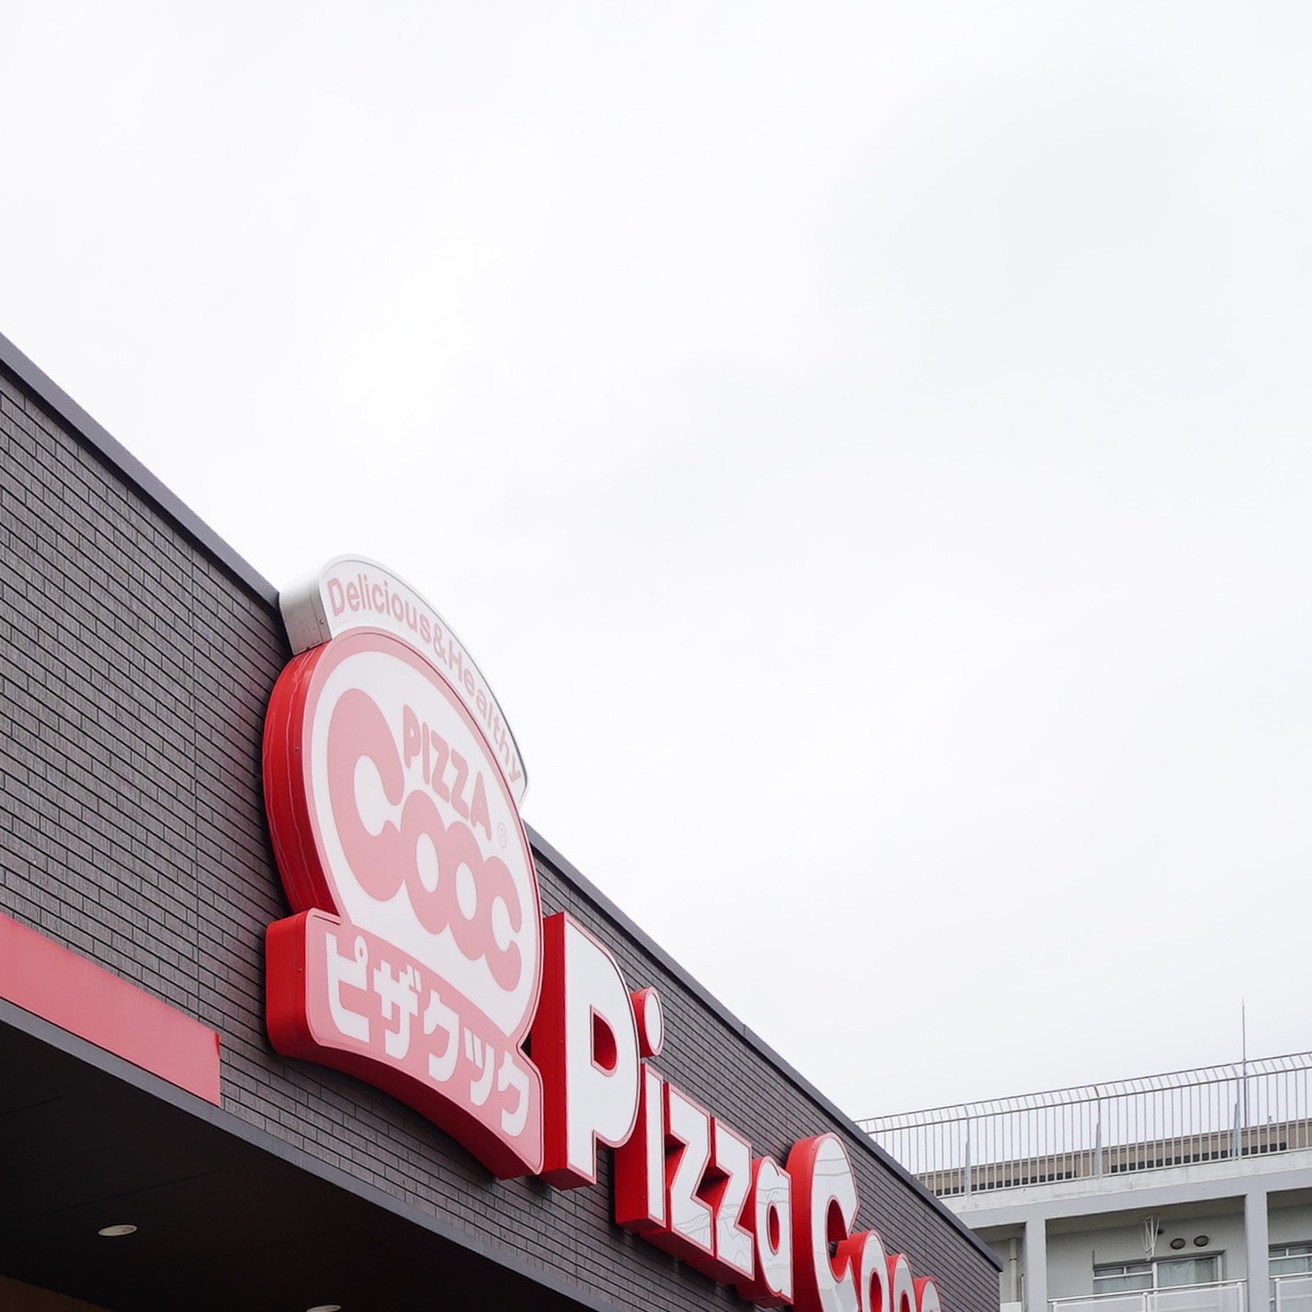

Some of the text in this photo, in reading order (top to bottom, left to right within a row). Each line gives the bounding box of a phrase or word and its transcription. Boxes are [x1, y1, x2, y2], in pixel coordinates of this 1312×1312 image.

[327, 573, 522, 783] Delicious&Healthy
[402, 703, 493, 841] PIZZA
[326, 930, 530, 1140] ピザクック
[546, 912, 793, 1308] Pizza
